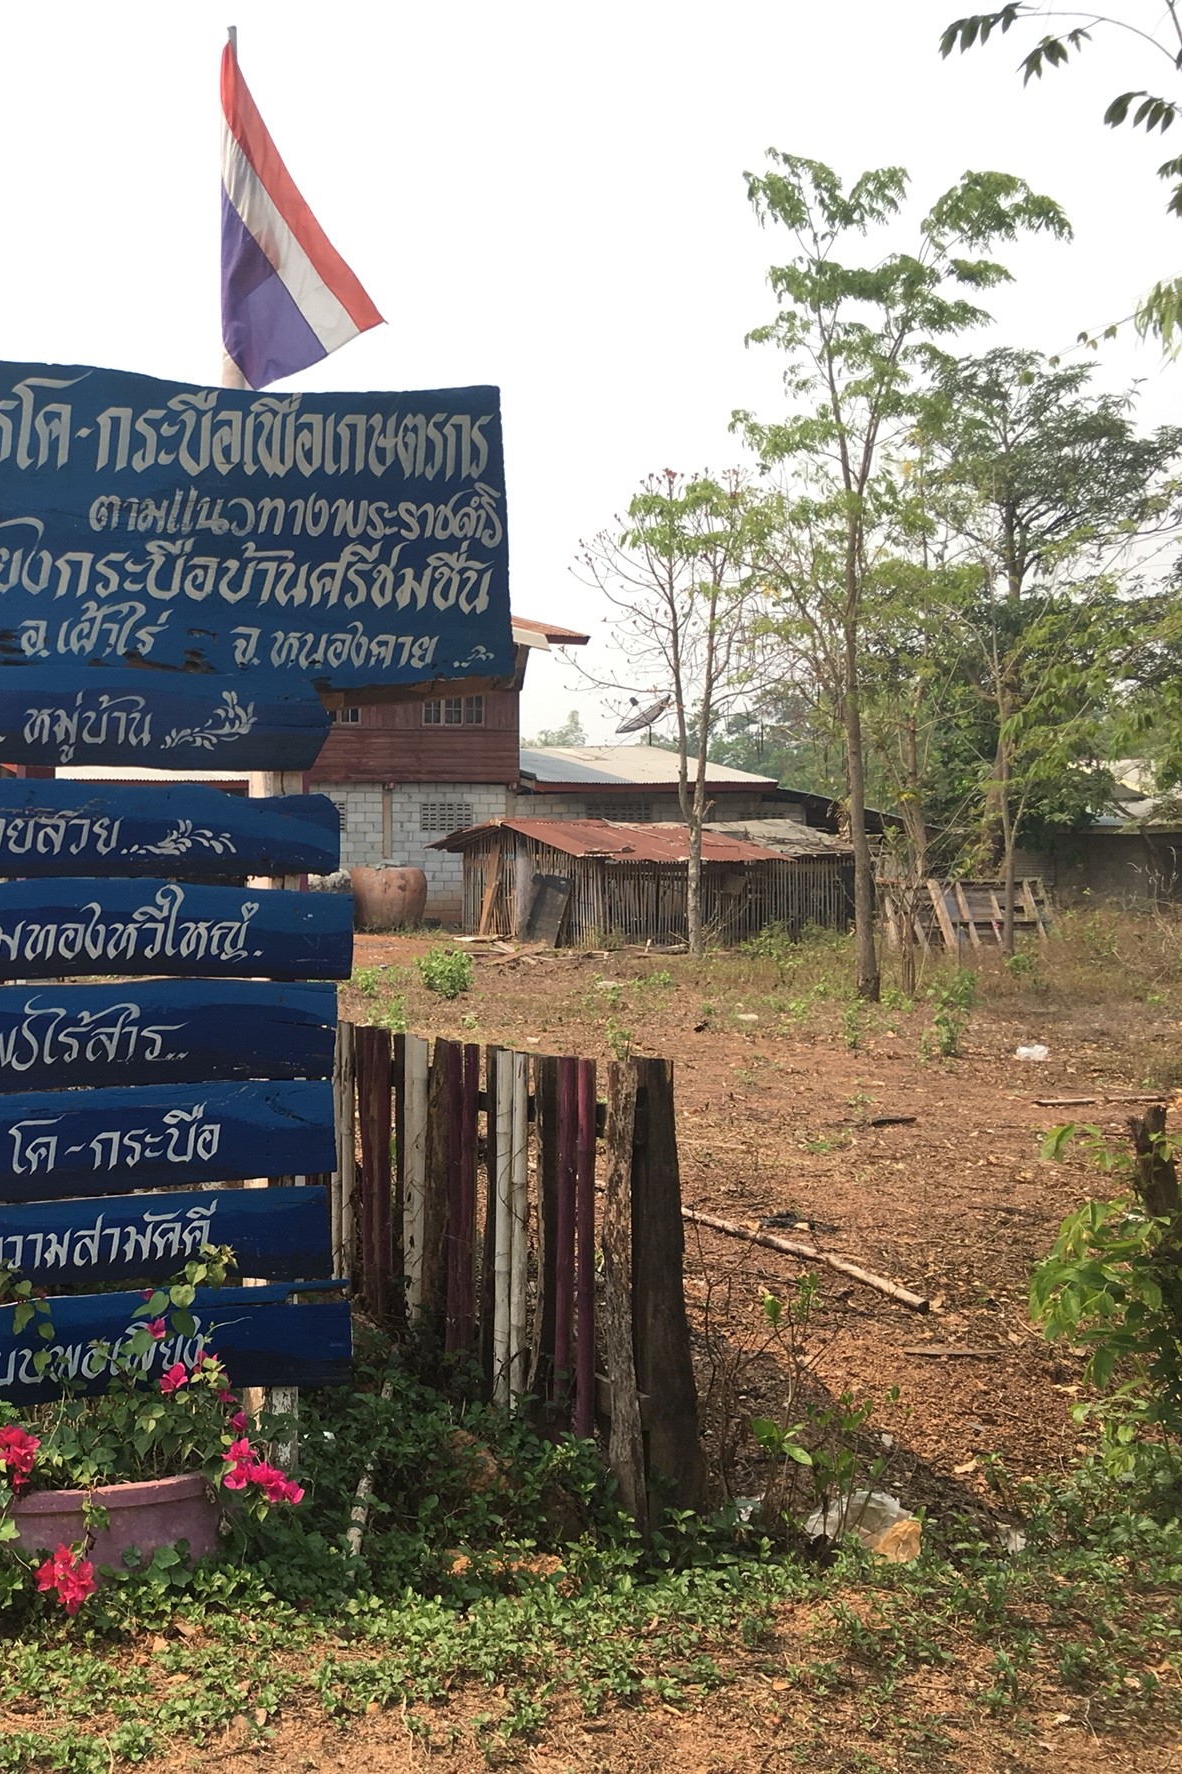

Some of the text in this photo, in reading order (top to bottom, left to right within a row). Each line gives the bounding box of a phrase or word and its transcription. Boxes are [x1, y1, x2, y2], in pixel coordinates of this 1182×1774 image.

[89, 482, 502, 549] ตามแนวทางพระราชดำริ
[23, 689, 153, 764] หมู่บ้าน
